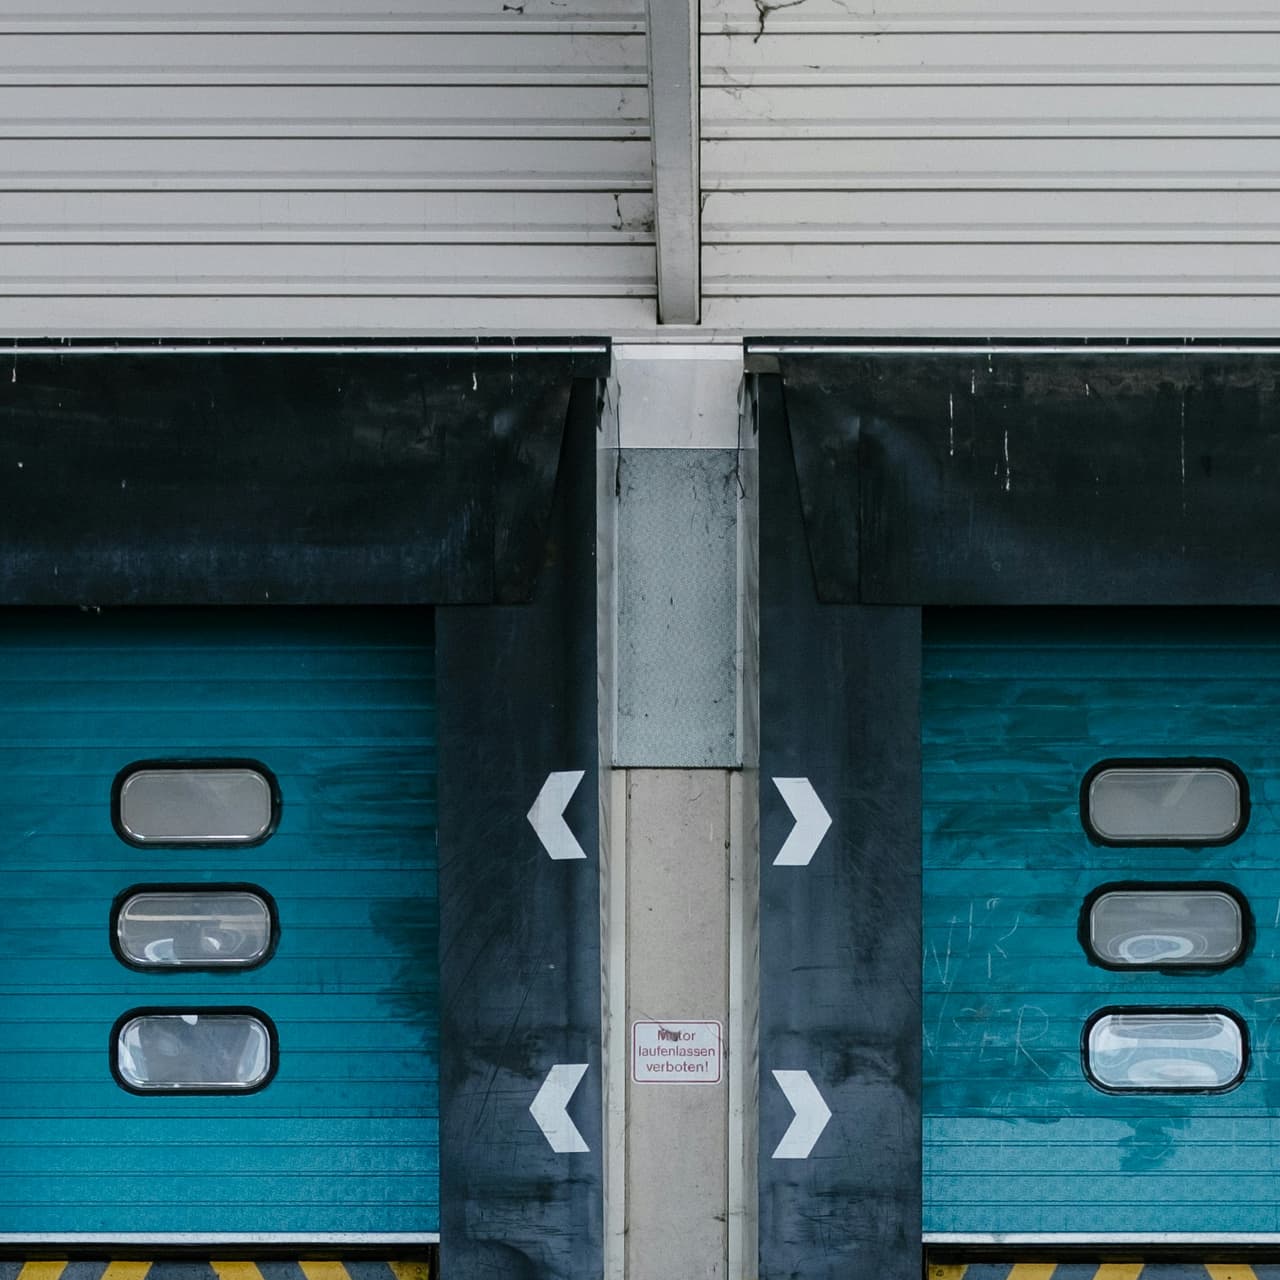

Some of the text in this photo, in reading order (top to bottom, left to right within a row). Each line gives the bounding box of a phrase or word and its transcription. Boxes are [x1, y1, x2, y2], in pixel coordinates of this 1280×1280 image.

[657, 1030, 696, 1041] Mtor
[638, 1045, 715, 1057] laufenlassen
[646, 1061, 709, 1073] verboten!
